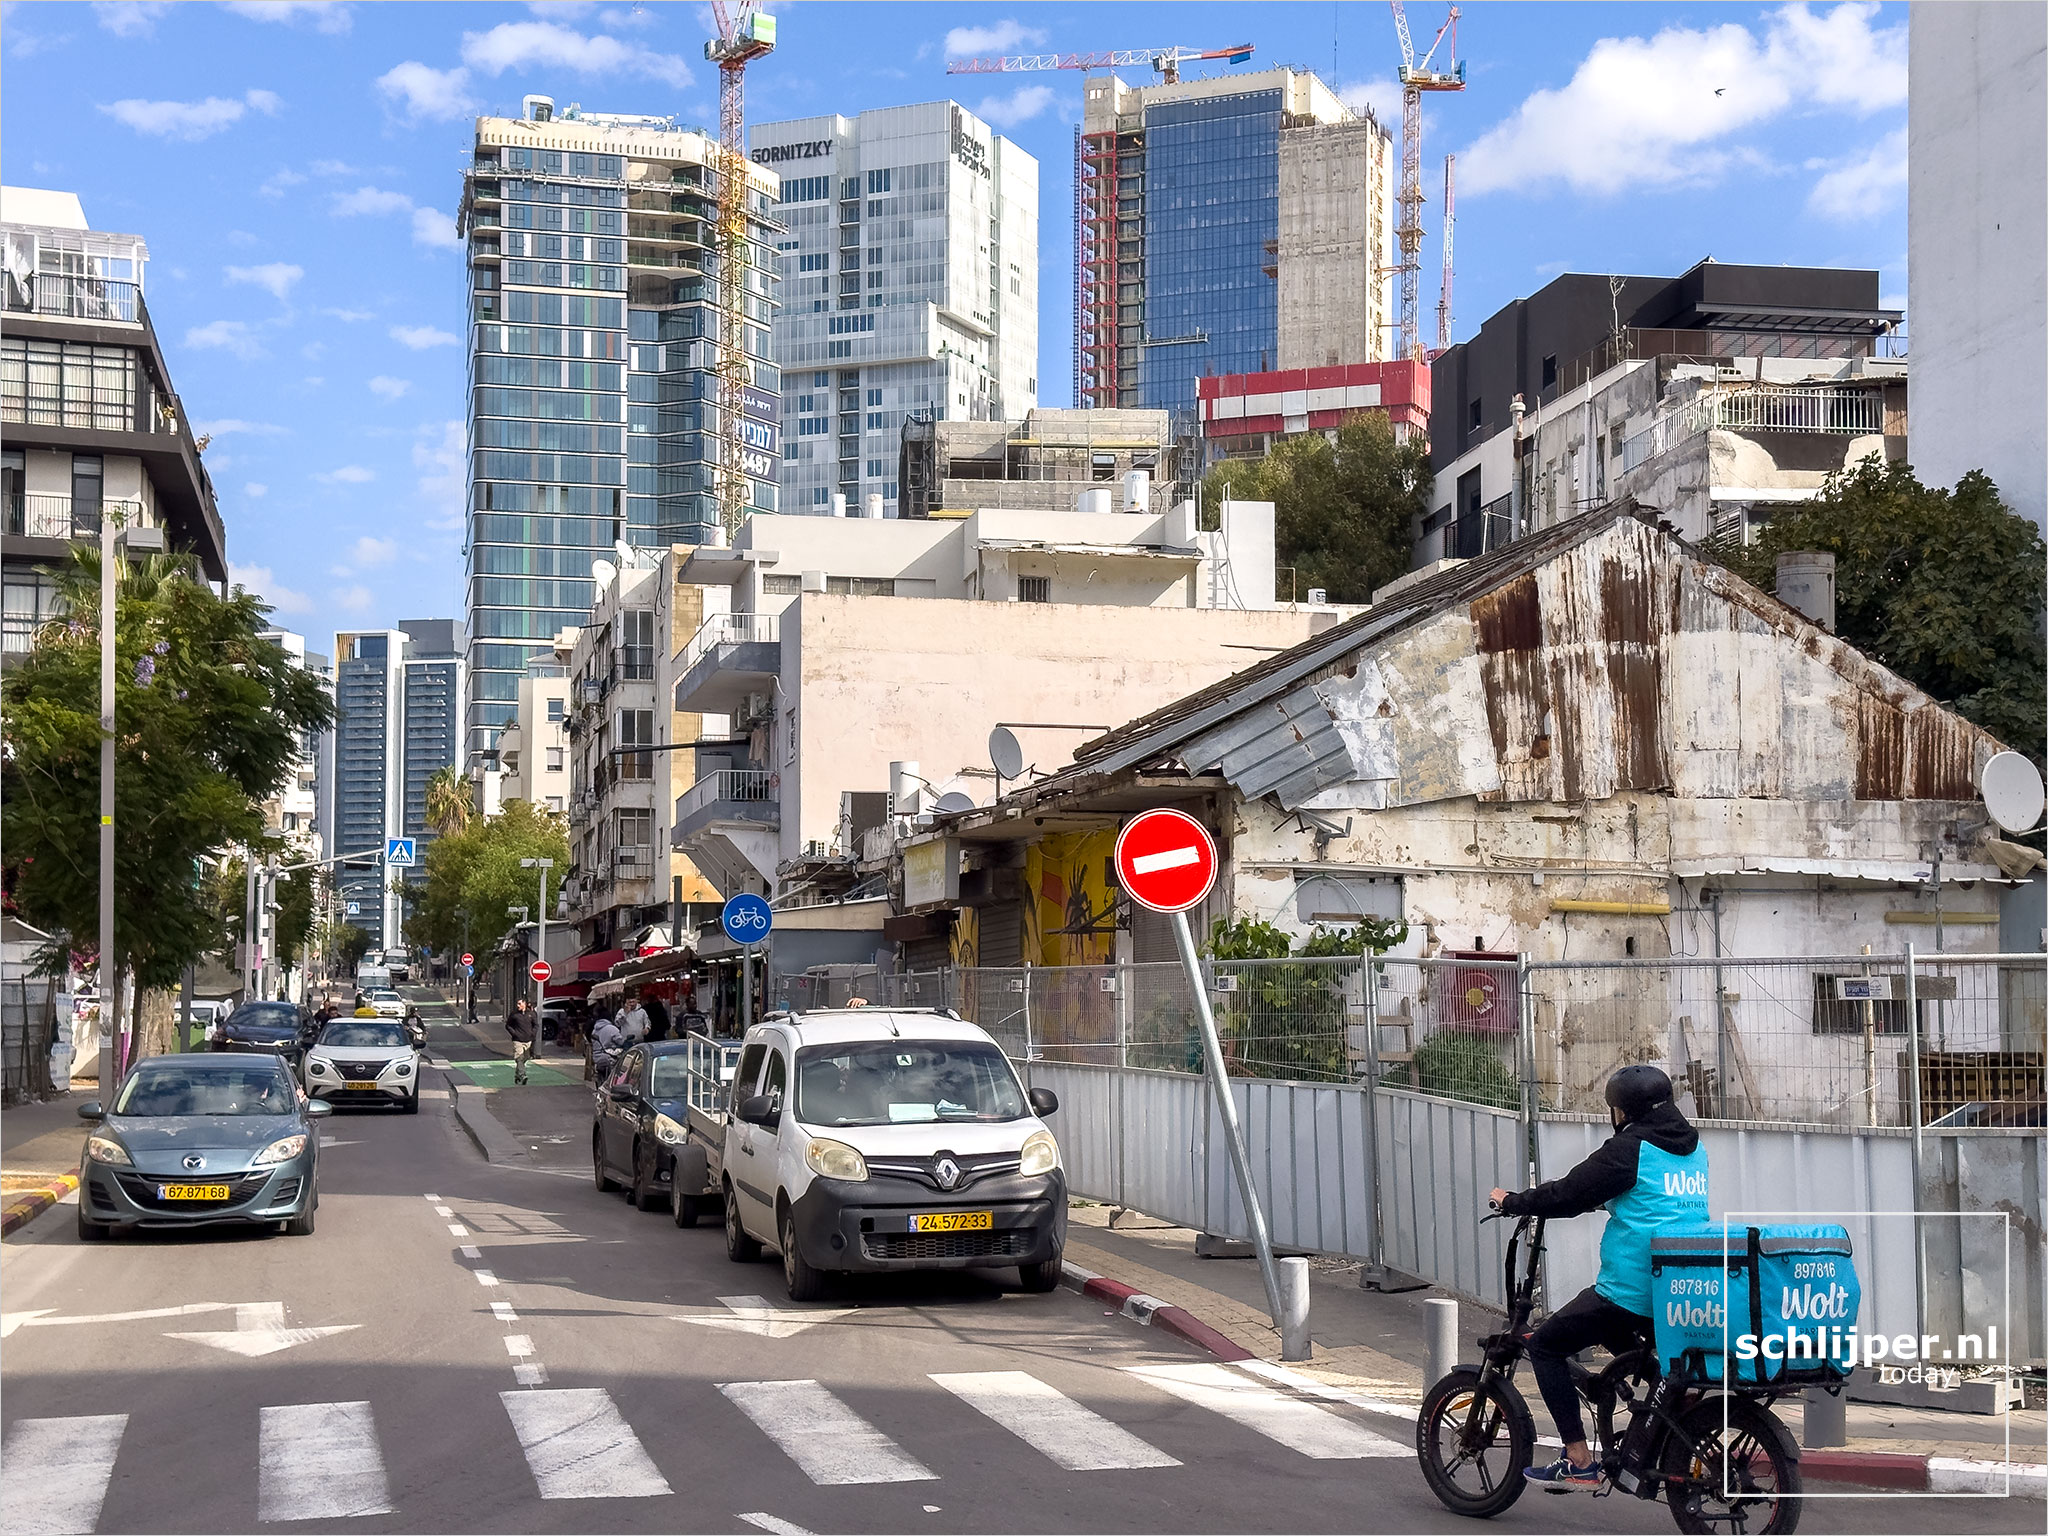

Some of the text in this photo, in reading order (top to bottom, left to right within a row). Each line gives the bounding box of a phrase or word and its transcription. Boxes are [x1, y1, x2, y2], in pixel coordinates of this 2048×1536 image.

[751, 139, 833, 163] GORNITZKY
[1664, 1170, 1707, 1196] Wolt
[1794, 1262, 1836, 1279] 897816
[1670, 1279, 1719, 1296] 897816
[1781, 1282, 1849, 1320] Wolt
[1666, 1300, 1726, 1328] Wolt
